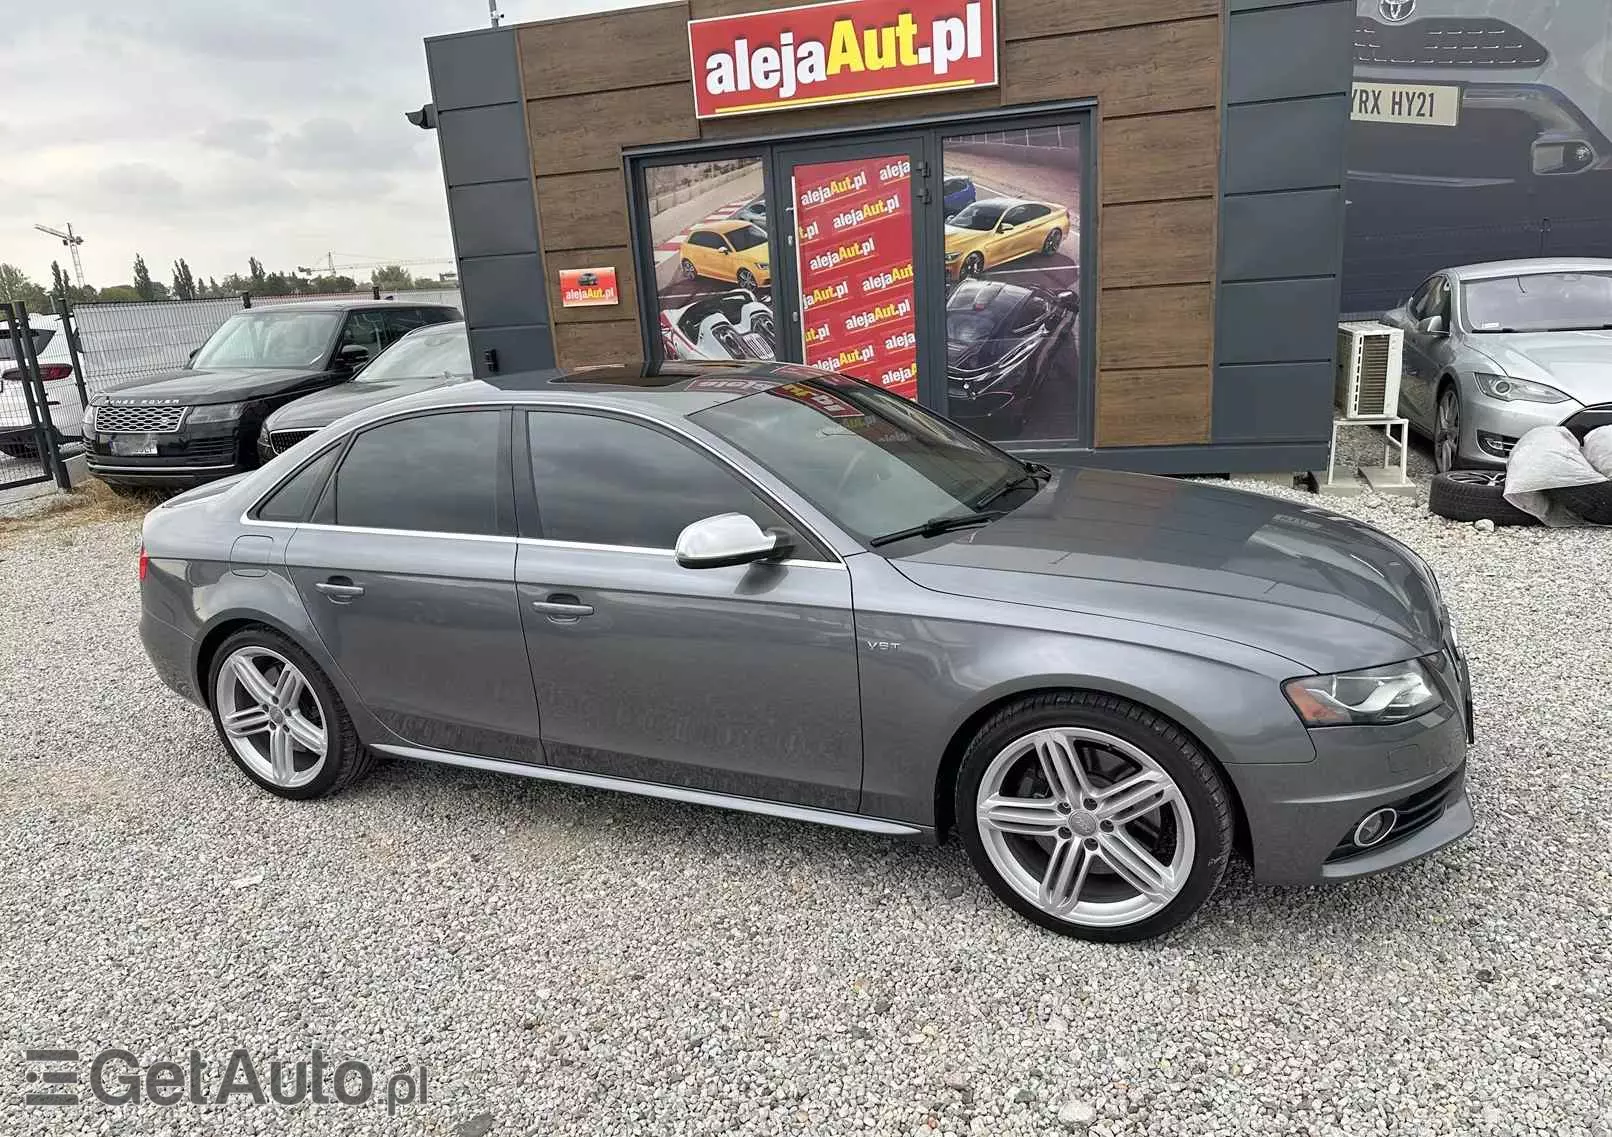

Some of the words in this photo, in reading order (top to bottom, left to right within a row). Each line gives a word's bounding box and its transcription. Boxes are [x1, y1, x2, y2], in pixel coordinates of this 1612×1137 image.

[705, 2, 982, 98] alejaAut.pl
[1391, 90, 1435, 117] HY21
[800, 171, 867, 206] alejaAut.pl
[879, 160, 910, 181] aleja
[832, 194, 900, 229] alejaAut.pl
[809, 237, 875, 270] alejaAut.pl
[565, 287, 614, 301] alejaAut.pl
[845, 299, 911, 330] alejaAut.pl
[885, 332, 916, 350] aleja
